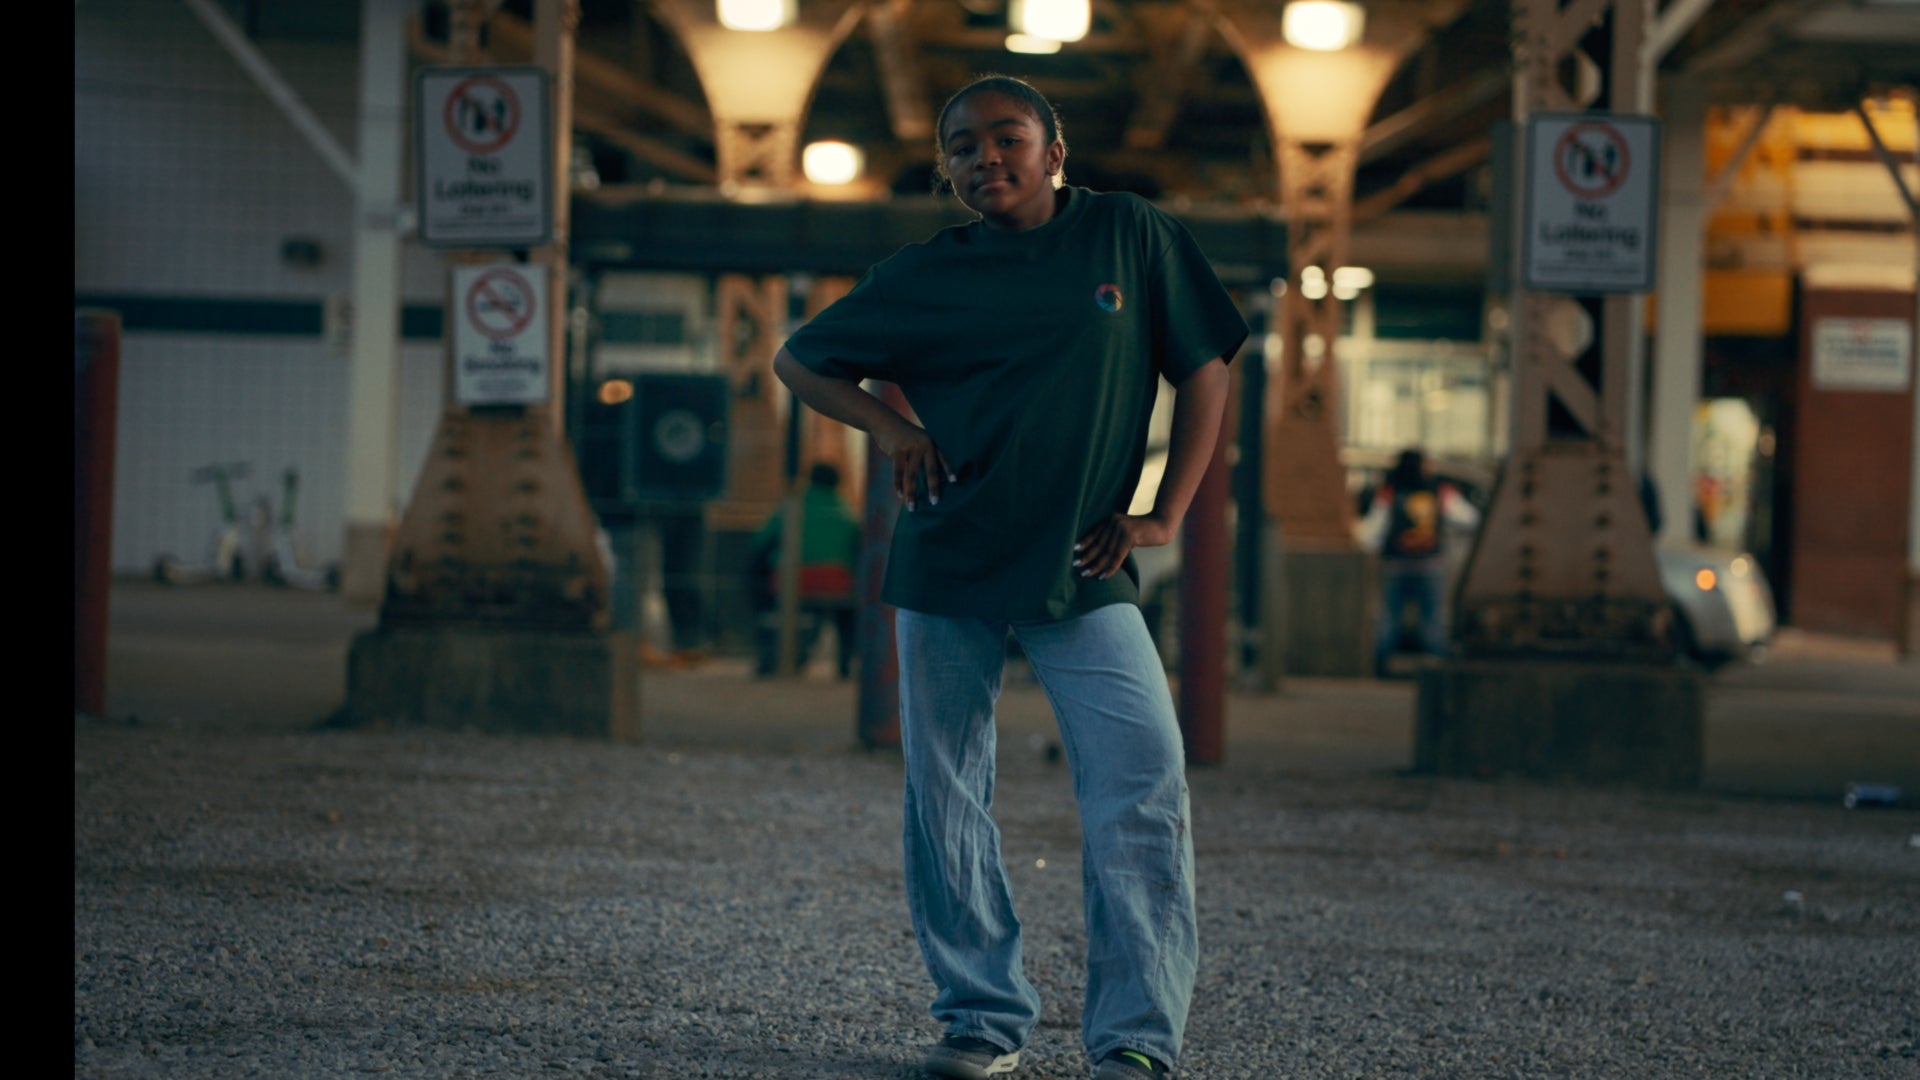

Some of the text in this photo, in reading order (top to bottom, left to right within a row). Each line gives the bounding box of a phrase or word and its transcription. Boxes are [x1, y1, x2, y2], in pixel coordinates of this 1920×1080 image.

[467, 157, 500, 174] No
[435, 179, 534, 203] Loitering
[1575, 201, 1608, 219] No
[1540, 222, 1640, 248] Loitering
